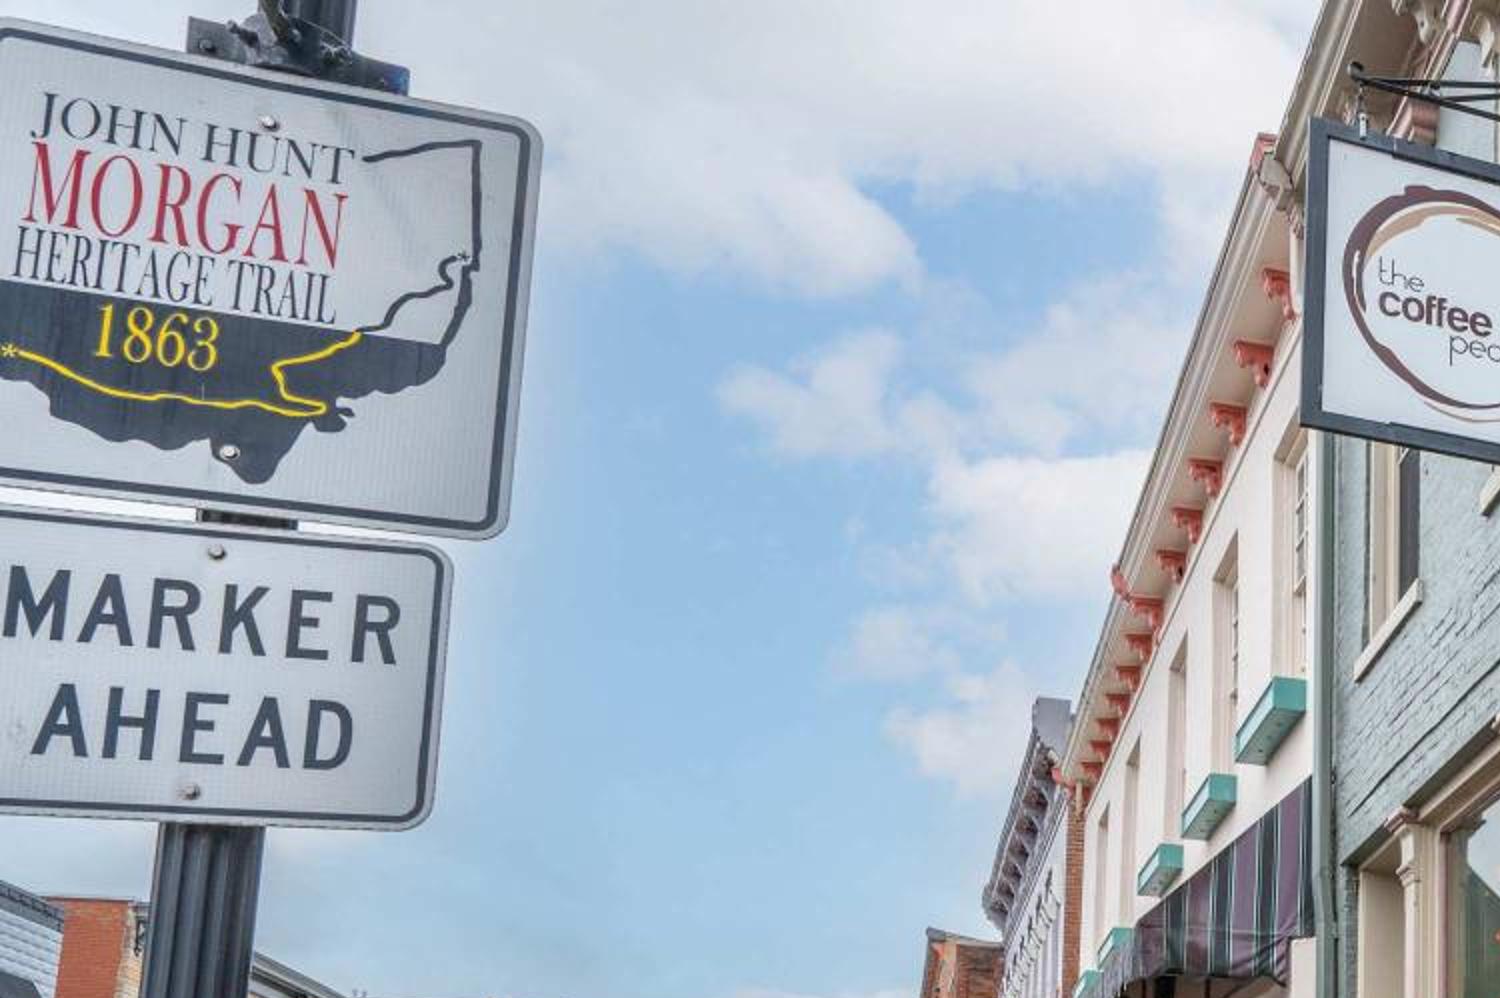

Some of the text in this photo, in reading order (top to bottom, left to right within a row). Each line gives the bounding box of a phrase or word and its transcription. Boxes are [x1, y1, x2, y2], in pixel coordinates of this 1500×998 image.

[30, 92, 355, 184] JOHN HUNT
[22, 142, 349, 268] MORGAN
[13, 226, 337, 325] HERITAGE TRAIL
[1378, 291, 1493, 337] coffee
[1379, 256, 1425, 291] the
[95, 303, 220, 371] 1863
[2, 565, 401, 664] MARKER
[30, 683, 353, 770] AHEAD
